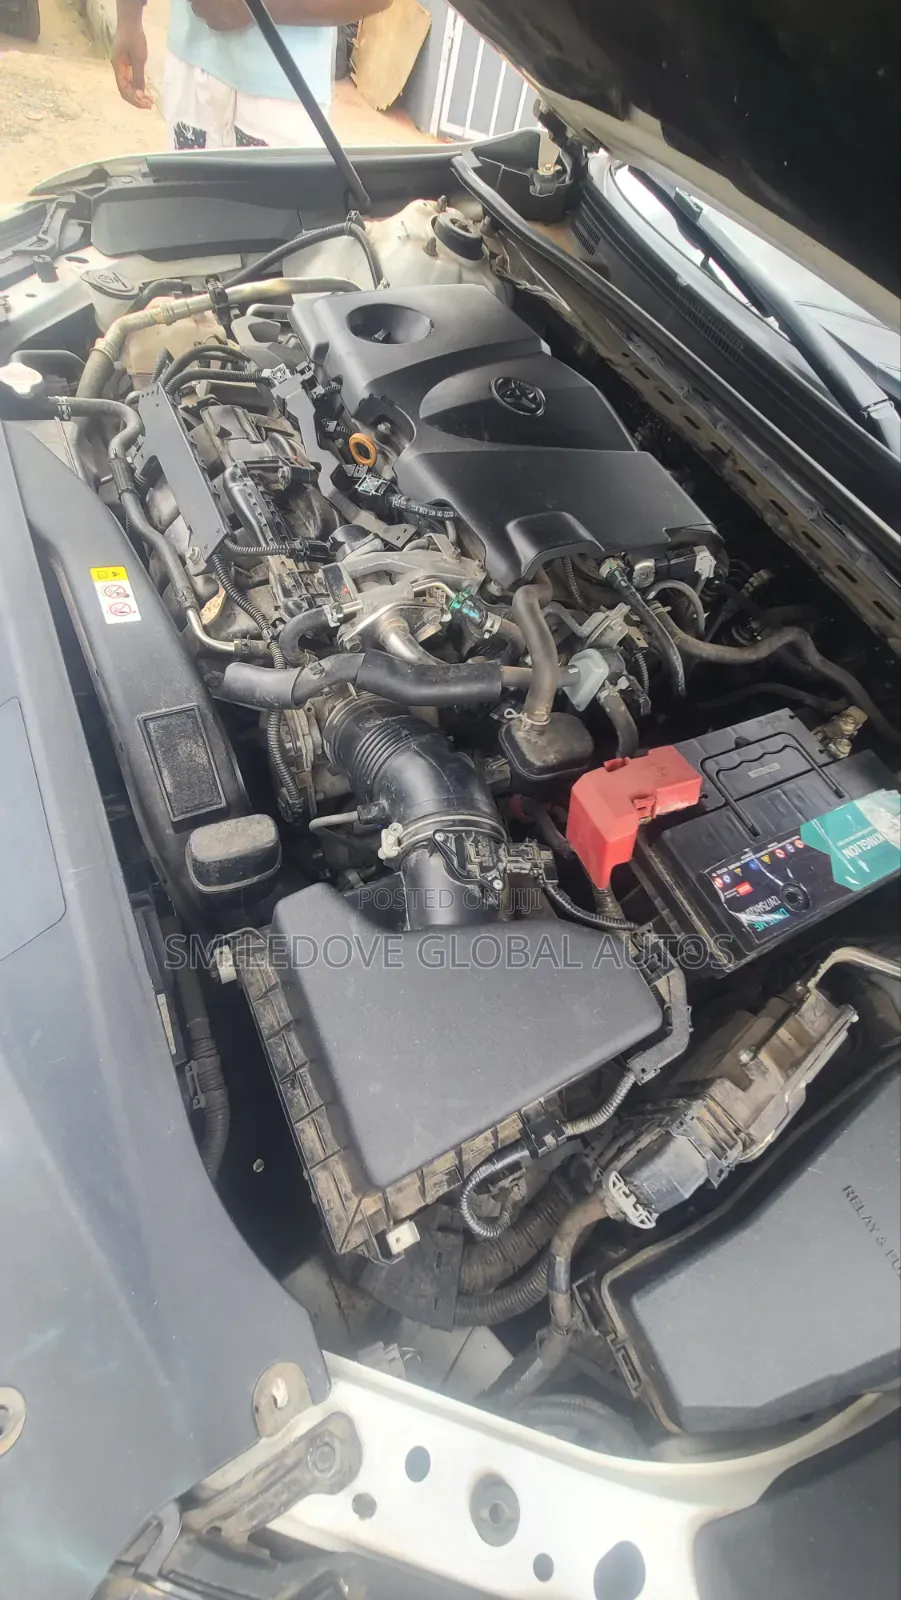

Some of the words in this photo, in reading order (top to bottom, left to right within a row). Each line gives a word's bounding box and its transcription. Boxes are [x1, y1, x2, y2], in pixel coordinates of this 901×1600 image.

[842, 832, 887, 859] KINGLION
[842, 1184, 881, 1234] RELAY
[875, 1236, 887, 1248] &
[885, 1249, 901, 1281] FU
